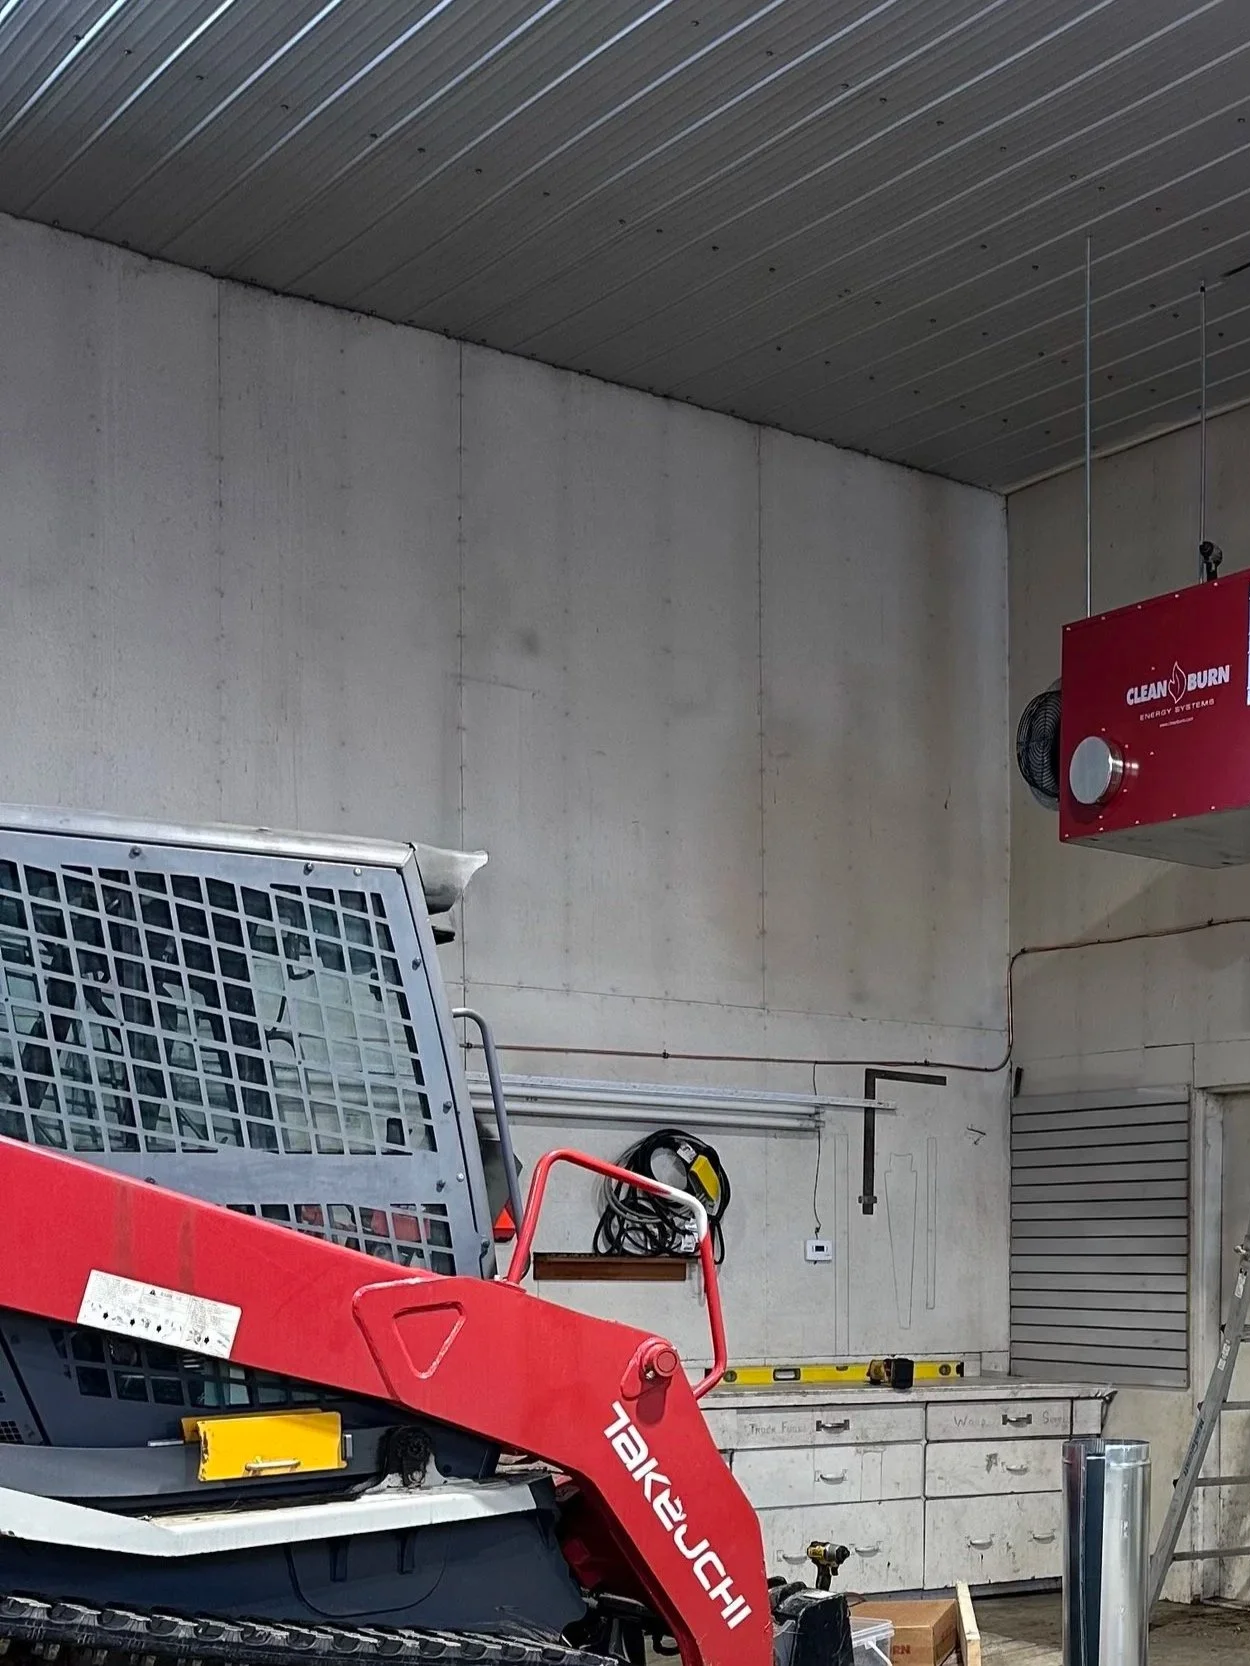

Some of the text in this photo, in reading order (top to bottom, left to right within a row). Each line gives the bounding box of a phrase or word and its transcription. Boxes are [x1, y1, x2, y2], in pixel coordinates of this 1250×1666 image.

[1126, 665, 1230, 705] CLEAN BURN
[1139, 698, 1215, 721] ENERGY SYSTEMS
